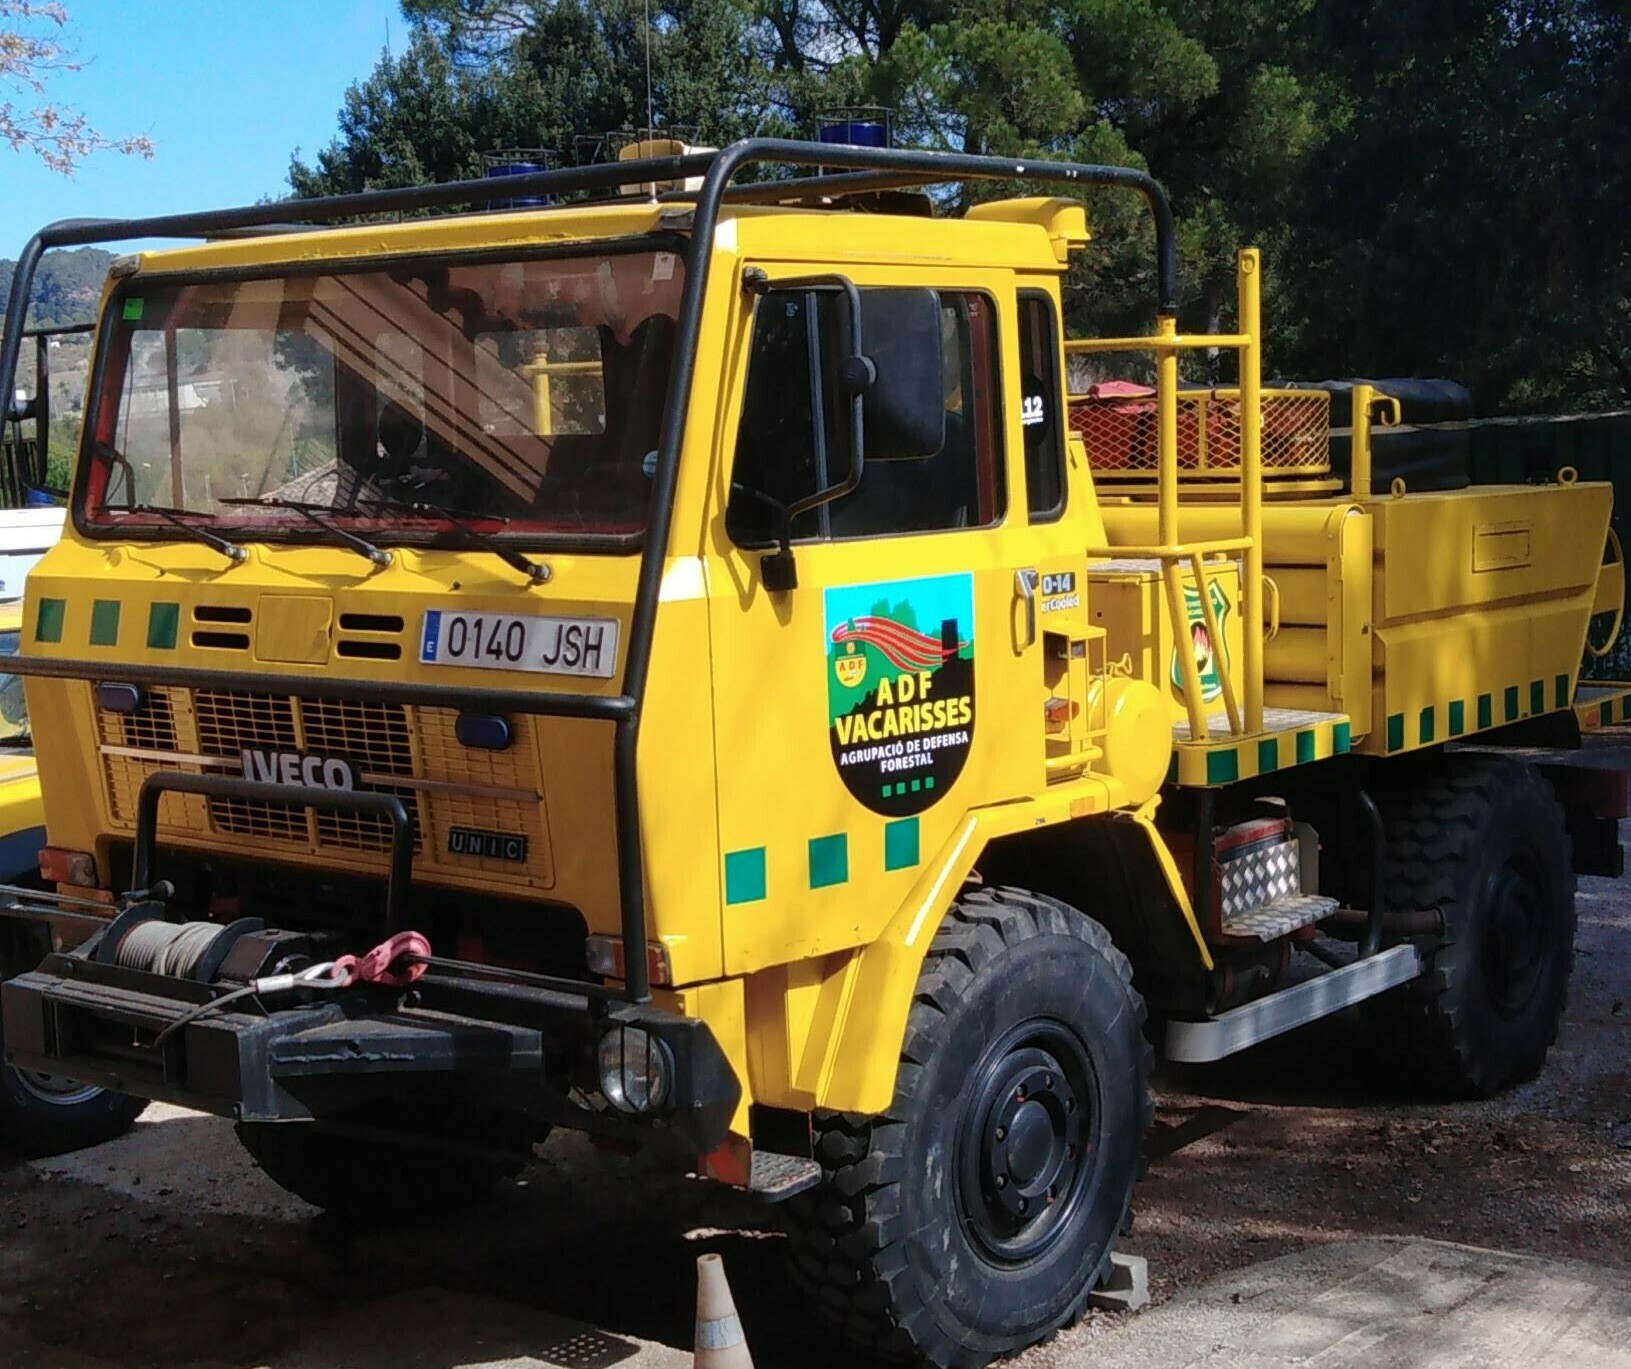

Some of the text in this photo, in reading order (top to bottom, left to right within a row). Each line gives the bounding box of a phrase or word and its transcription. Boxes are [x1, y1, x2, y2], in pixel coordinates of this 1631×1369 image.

[1021, 396, 1043, 418] 12
[426, 616, 604, 669] E 0140 JSH
[835, 696, 972, 745] VACARISSES
[840, 731, 969, 766] AGRUPACIÓ DE DEFENSA
[880, 752, 934, 773] FORESTAL
[241, 750, 354, 792] IVECO
[451, 832, 519, 858] UNIC
